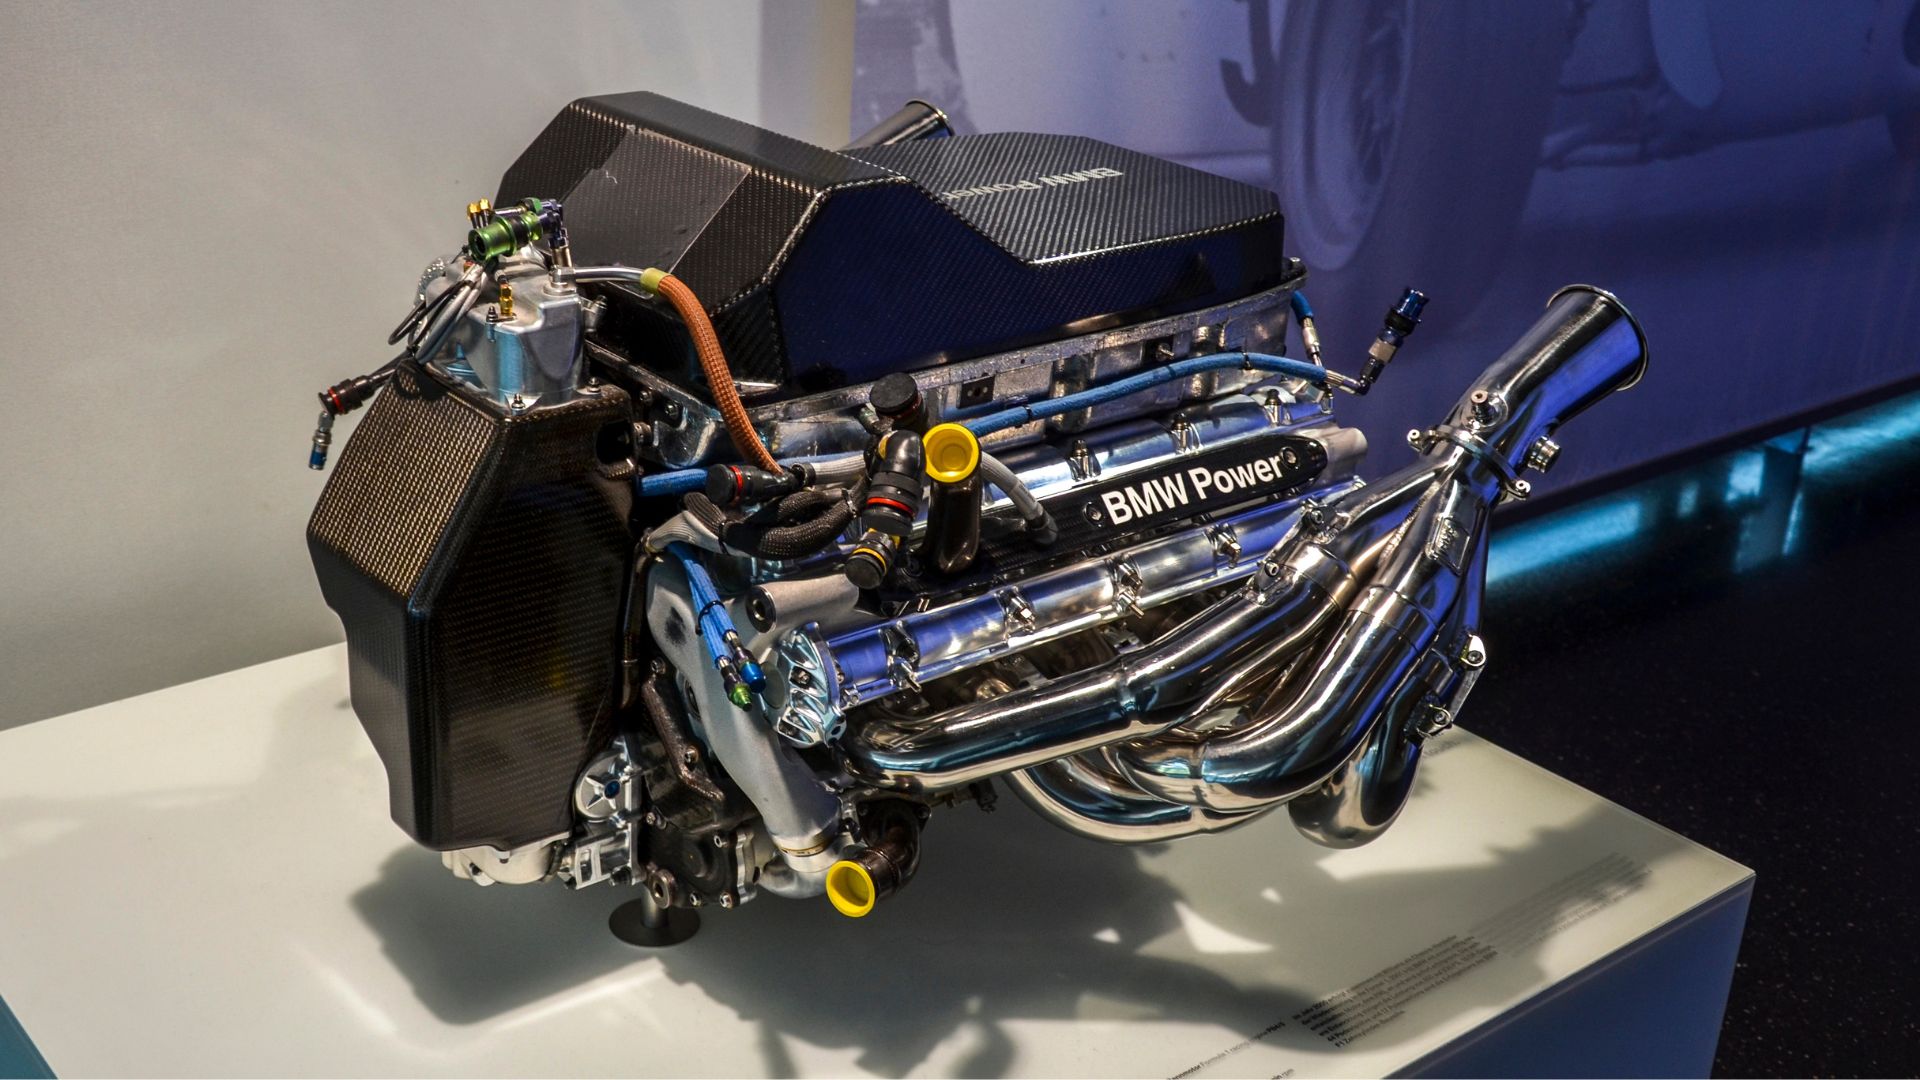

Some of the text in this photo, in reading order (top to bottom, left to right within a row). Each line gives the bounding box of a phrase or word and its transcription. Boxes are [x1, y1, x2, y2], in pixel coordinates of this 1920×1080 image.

[1039, 167, 1124, 187] BMW
[1101, 455, 1283, 525] BMW Power
